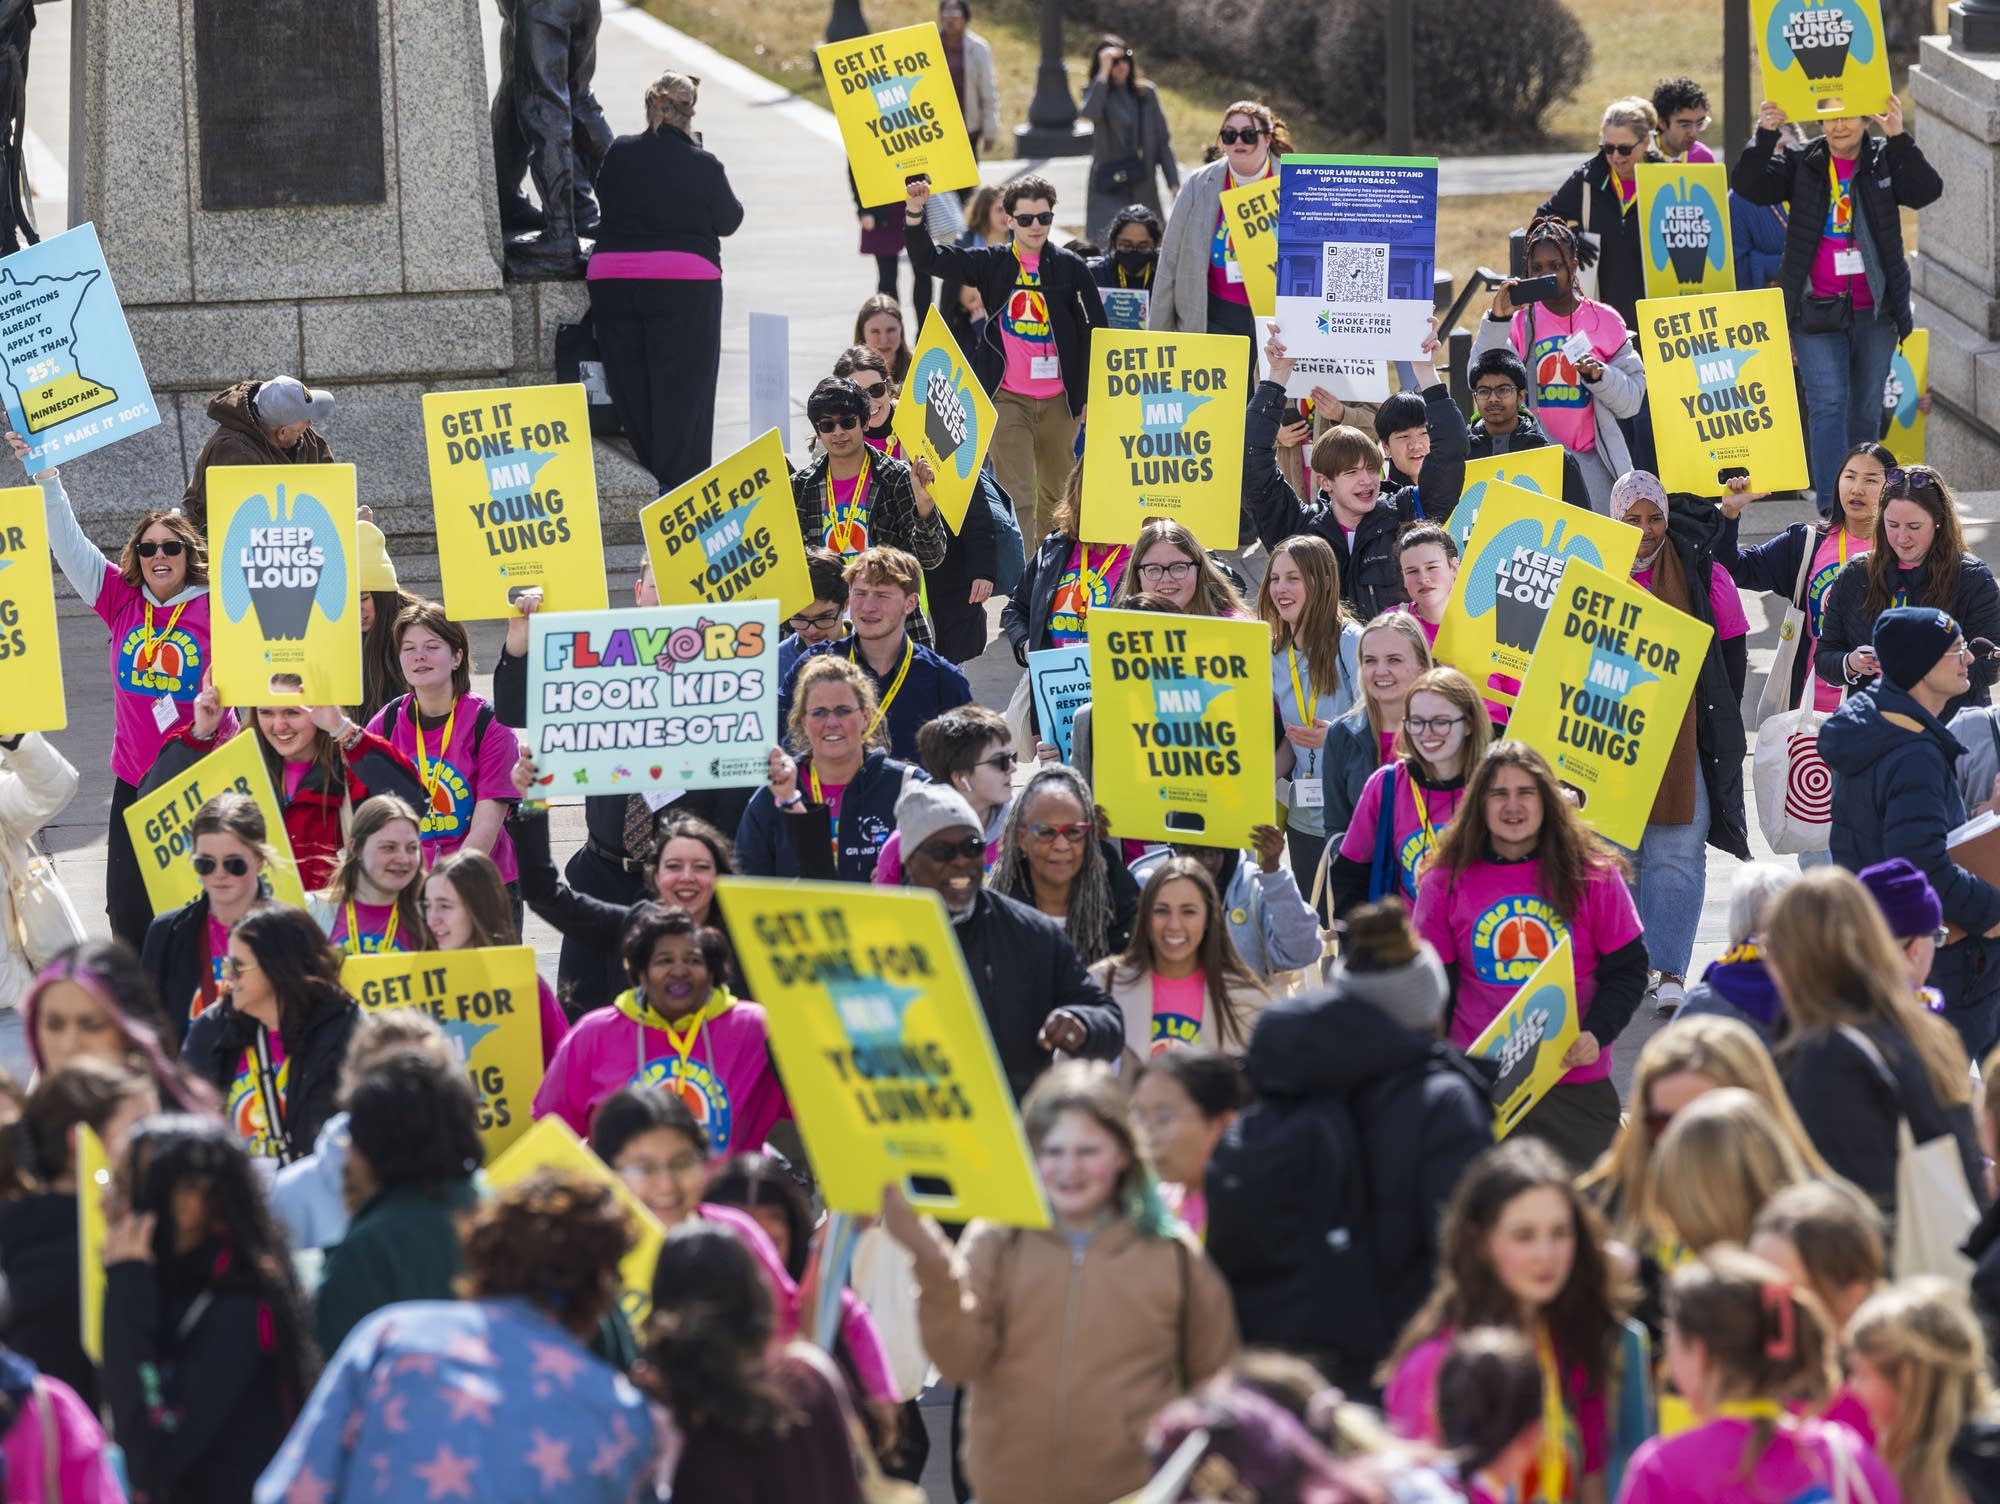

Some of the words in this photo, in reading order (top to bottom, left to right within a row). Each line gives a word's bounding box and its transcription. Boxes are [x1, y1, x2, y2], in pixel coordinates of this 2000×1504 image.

[1782, 20, 1854, 38] LUNGS
[1789, 9, 1843, 25] KEEP
[1791, 33, 1850, 50] LOUD
[834, 52, 866, 75] GET
[869, 44, 886, 64] IT
[841, 65, 891, 95] DONE
[894, 51, 931, 76] FOR
[876, 85, 907, 109] MN
[866, 101, 935, 138] YOUNG
[881, 121, 944, 156] LUNGS
[1237, 194, 1268, 220] GET
[1272, 187, 1280, 204] I
[1665, 206, 1703, 219] KEEP
[1244, 209, 1279, 239] DON
[1660, 218, 1711, 234] LUNGS
[1665, 233, 1709, 248] LOUD
[0, 290, 60, 322] ESTRICTIONS
[2, 313, 42, 337] ALREADY
[1013, 321, 1050, 336] OUD
[1331, 326, 1391, 334] GENERATION
[1332, 318, 1391, 326] SMOKE-FREE
[1654, 312, 1691, 339] GET
[1698, 307, 1718, 329] IT
[7, 334, 34, 352] APPLY
[39, 327, 52, 339] TO
[12, 349, 38, 366] MORE
[43, 336, 69, 354] THAN
[1658, 332, 1720, 363] DONE
[1725, 321, 1770, 348] FOR
[26, 357, 61, 383] 25%
[1107, 348, 1148, 372] GET
[1157, 346, 1177, 368] IT
[1292, 363, 1375, 375] GENERATION
[1700, 359, 1735, 384] MN
[42, 388, 54, 399] OF
[936, 368, 967, 420] KEEP
[1108, 371, 1172, 397] DONE
[1182, 368, 1227, 392] FOR
[30, 387, 100, 422] MINNESOTANS
[927, 386, 960, 445] LOUD
[928, 369, 968, 440] LUNGS
[1146, 403, 1183, 425] MN
[1680, 382, 1766, 418] YOUNG
[29, 440, 60, 460] LET'S
[64, 422, 100, 446] MAKE
[103, 417, 114, 429] IT
[118, 402, 149, 423] 100%
[442, 409, 483, 438] GET
[492, 403, 513, 429] IT
[1696, 406, 1773, 443] LUNGS
[447, 431, 514, 465] DONE
[520, 421, 569, 451] FOR
[1120, 430, 1211, 459] YOUNG
[491, 462, 530, 491] MN
[1132, 458, 1213, 486] LUNGS
[469, 489, 564, 529] YOUNG
[659, 496, 696, 535] GET
[701, 478, 721, 504] IT
[666, 502, 725, 557] DONE
[728, 467, 771, 508] FOR
[251, 527, 314, 547] KEEP
[486, 517, 571, 556] LUNGS
[705, 519, 741, 557] MN
[240, 546, 324, 567] LUNGS
[690, 527, 770, 595] YOUNG
[1512, 545, 1565, 576] KEE
[248, 567, 318, 589] LOUD
[1497, 577, 1555, 609] LOU
[1572, 586, 1615, 620] GET
[1618, 602, 1642, 631] IT
[544, 618, 765, 674] FLAVORS
[1107, 630, 1153, 654] GET
[1165, 629, 1187, 653] IT
[1563, 612, 1629, 656] DONE
[1635, 636, 1680, 675] FOR
[131, 671, 182, 692] LOUD
[1111, 656, 1187, 681] DONE
[1194, 655, 1248, 679] FOR
[1590, 659, 1630, 693] MN
[543, 676, 659, 714] HOOK
[671, 669, 764, 706] KIDS
[1049, 682, 1092, 695] FLAVOR
[1159, 690, 1202, 713] MN
[1560, 682, 1645, 736] YOUNG
[541, 711, 763, 754] MINNESOTA
[1131, 721, 1236, 748] YOUNG
[1558, 715, 1640, 766] LUNGS
[1147, 750, 1241, 777] LUNGS
[145, 800, 180, 844] GET
[183, 781, 203, 812] IT
[154, 819, 193, 869] DON
[1475, 904, 1509, 949] KEEP
[1495, 961, 1543, 982] LOU
[362, 974, 411, 1007] GET
[422, 968, 447, 998] IT
[456, 989, 514, 1022] FOR
